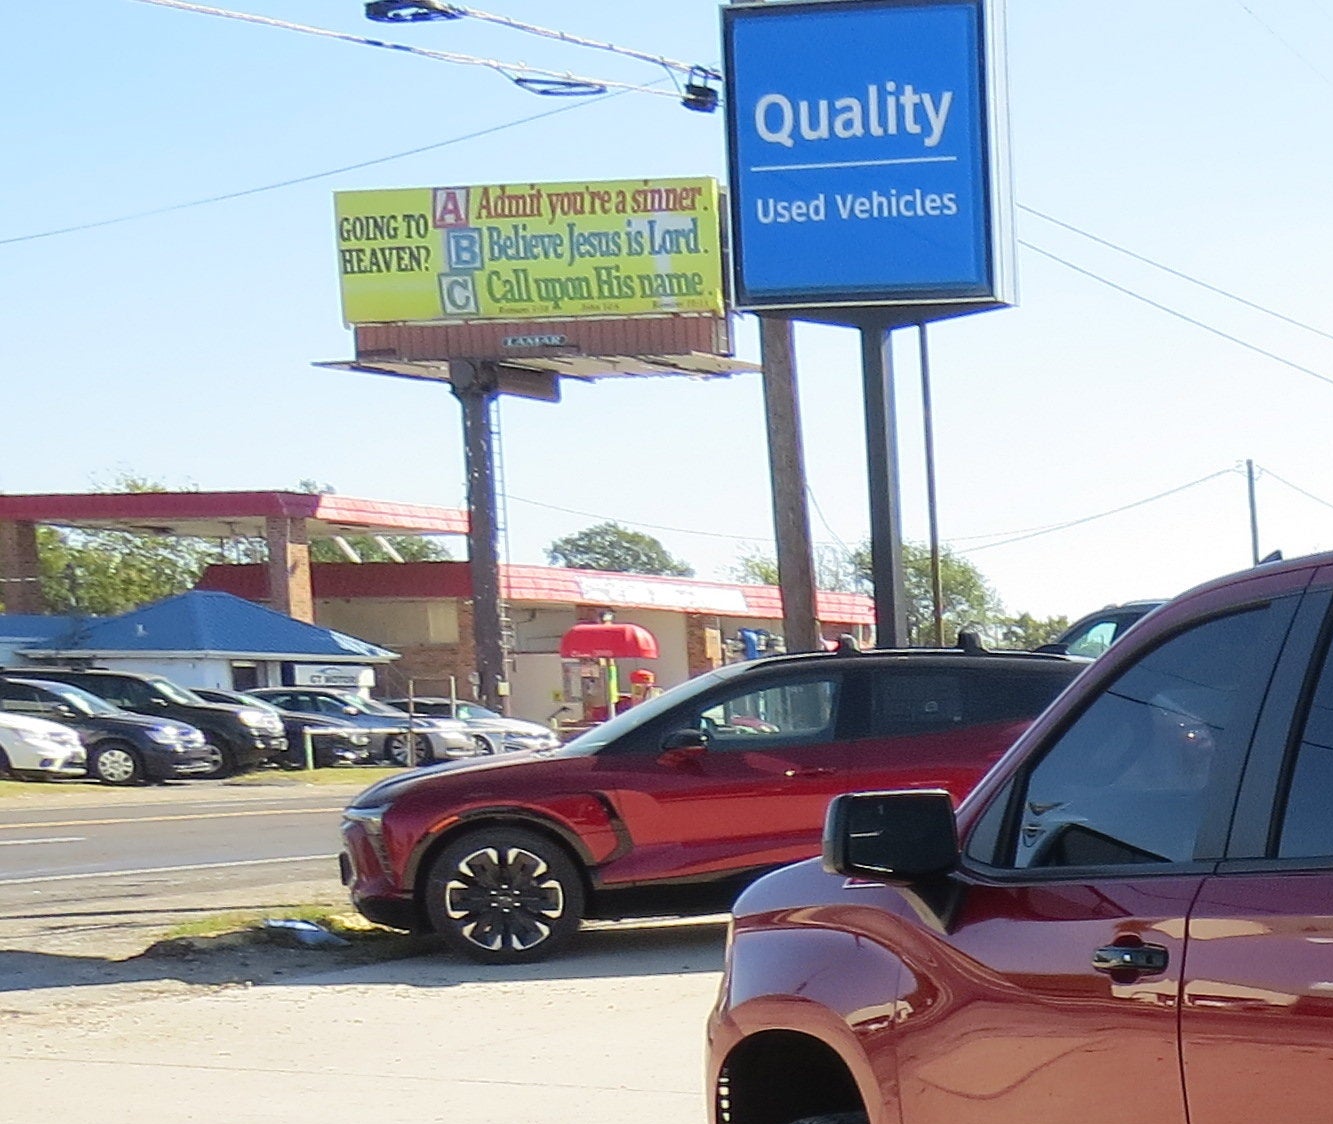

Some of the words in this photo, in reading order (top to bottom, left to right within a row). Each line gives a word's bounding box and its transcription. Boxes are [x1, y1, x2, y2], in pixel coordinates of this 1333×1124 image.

[754, 81, 953, 148] Quality
[437, 191, 464, 224] A
[476, 184, 543, 219] Admit
[547, 186, 611, 225] you're
[615, 189, 626, 214] a
[756, 193, 826, 224] Used
[834, 188, 958, 220] Vehicles
[339, 214, 398, 242] GOING
[402, 213, 430, 239] TO
[452, 234, 479, 265] B
[487, 223, 563, 262] Believe
[567, 221, 621, 266] Jesus
[625, 218, 644, 256] is
[340, 245, 432, 274] HEAVEN?
[448, 278, 471, 310] C
[487, 268, 534, 304] Call
[535, 275, 594, 310] upon
[594, 264, 635, 300] His
